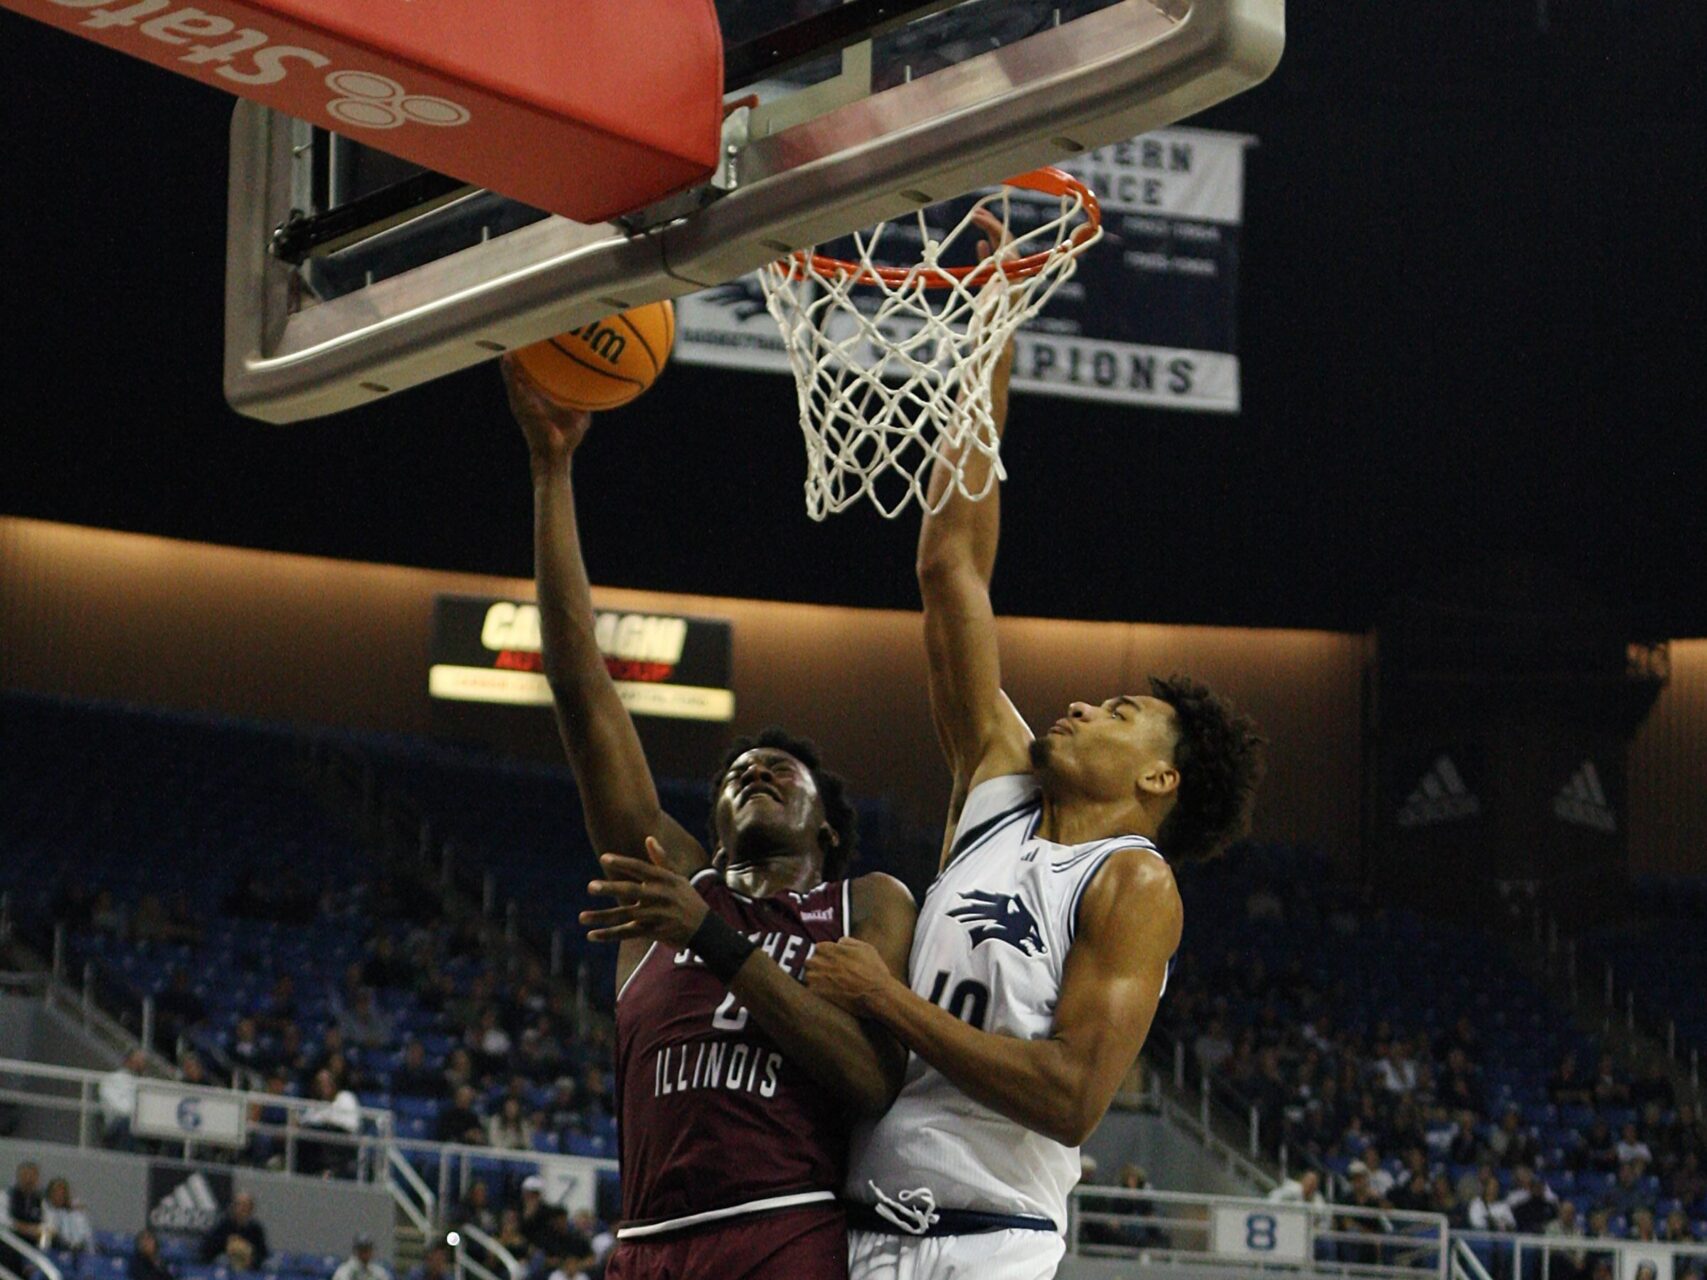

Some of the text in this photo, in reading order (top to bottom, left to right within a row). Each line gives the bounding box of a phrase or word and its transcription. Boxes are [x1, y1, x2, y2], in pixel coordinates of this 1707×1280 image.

[655, 1041, 783, 1098] ILLINOIS
[177, 1097, 202, 1132] 6
[558, 1173, 579, 1205] 7
[1246, 1214, 1277, 1251] 8
